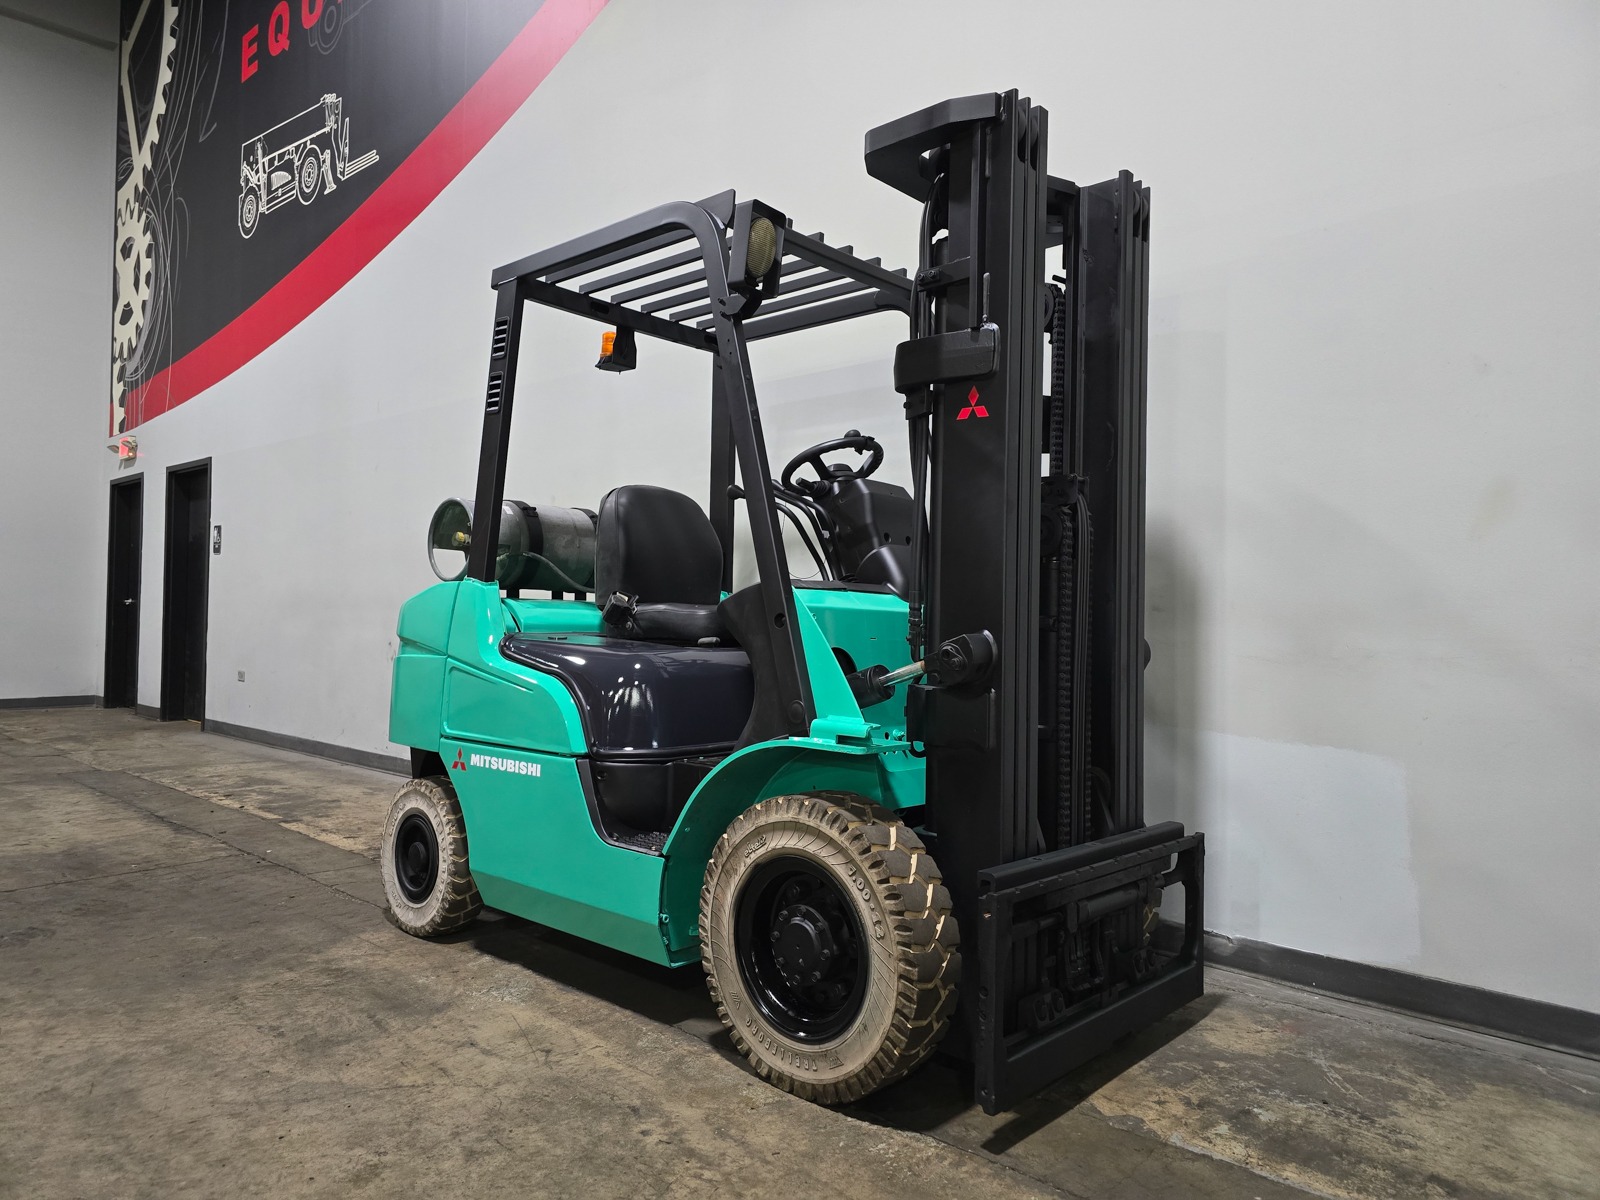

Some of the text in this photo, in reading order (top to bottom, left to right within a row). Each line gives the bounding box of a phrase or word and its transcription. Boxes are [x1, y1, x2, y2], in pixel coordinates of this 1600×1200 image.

[241, 0, 342, 83] EQU
[470, 753, 541, 777] MITSUBISHI
[746, 1018, 818, 1072] TRELLEBORG
